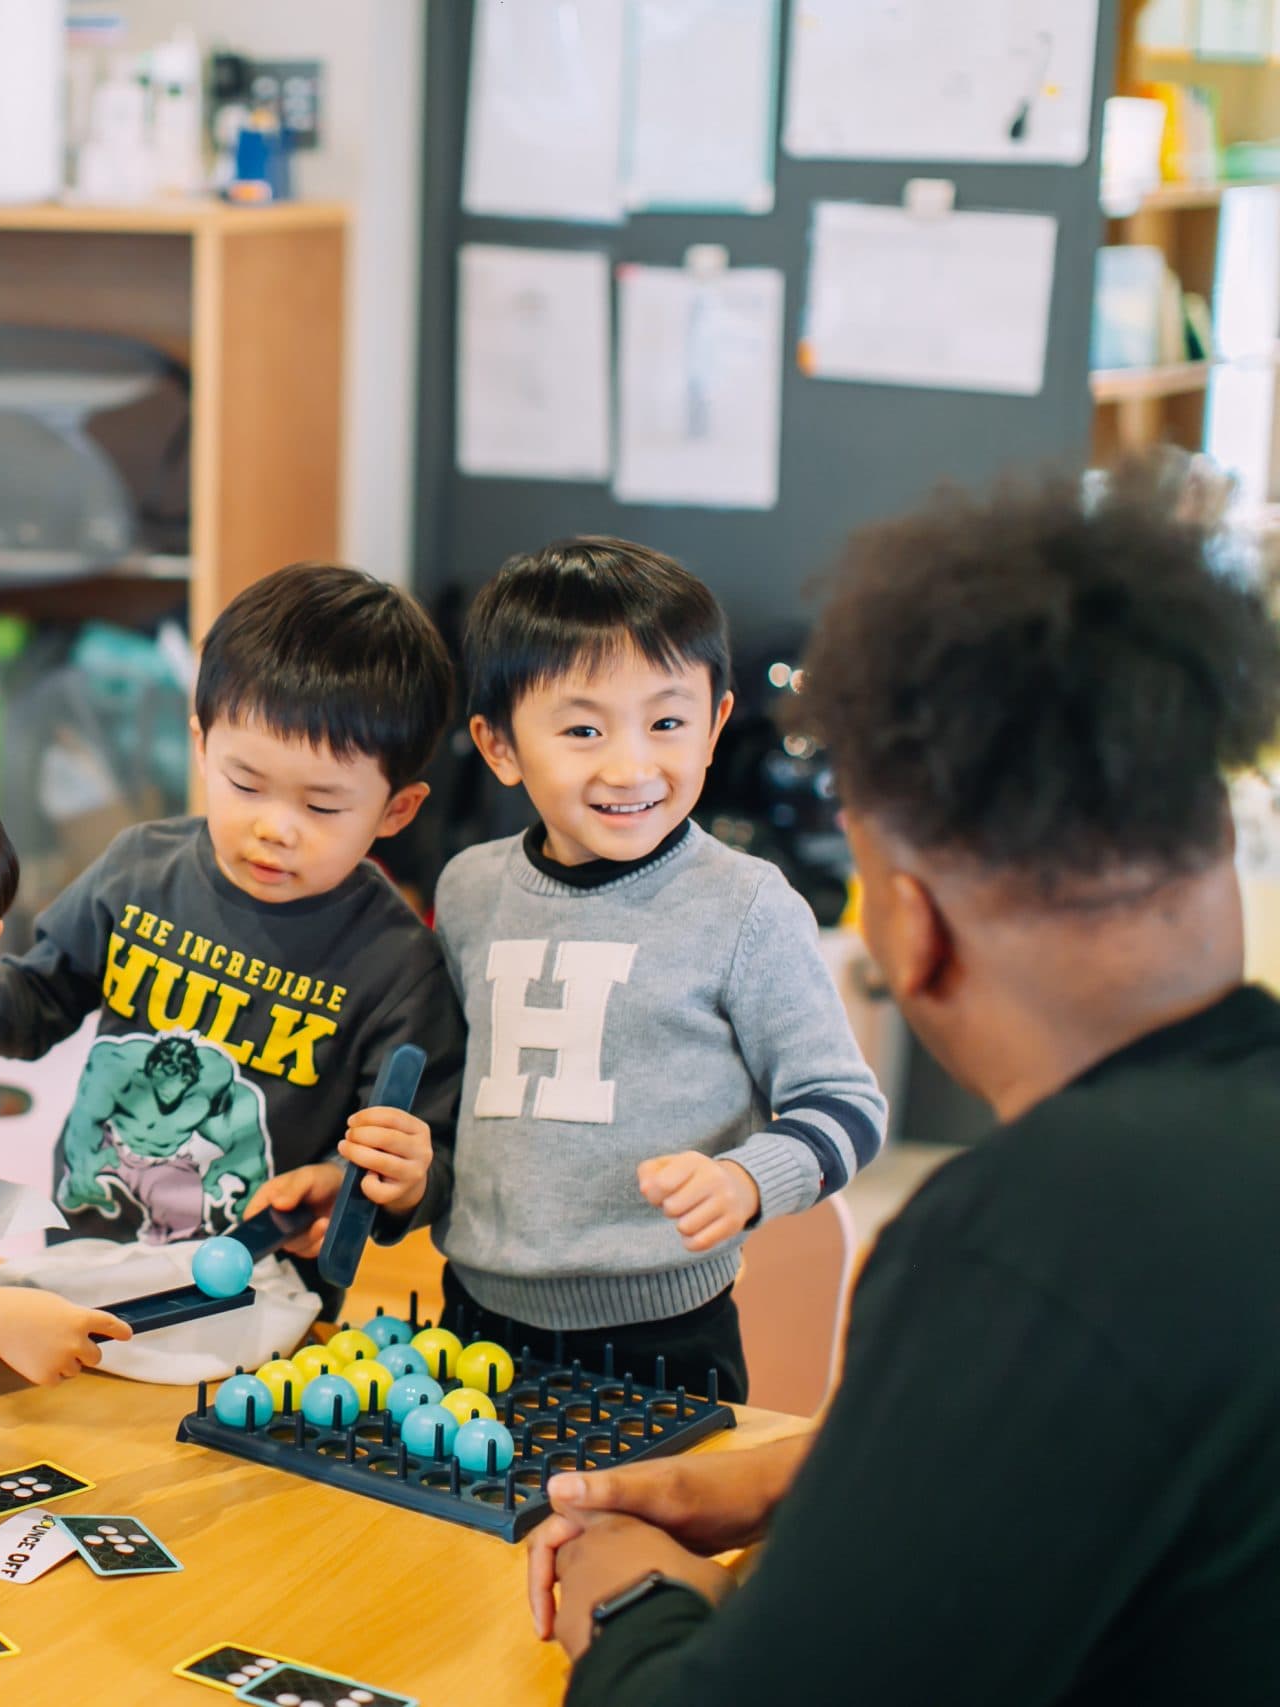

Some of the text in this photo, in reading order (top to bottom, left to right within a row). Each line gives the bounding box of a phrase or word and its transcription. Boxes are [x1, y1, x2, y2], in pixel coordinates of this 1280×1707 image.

[103, 932, 338, 1086] HULK
[120, 904, 347, 1012] THE INCREDIBLE
[474, 938, 639, 1125] H
[1, 1553, 30, 1578] OFF
